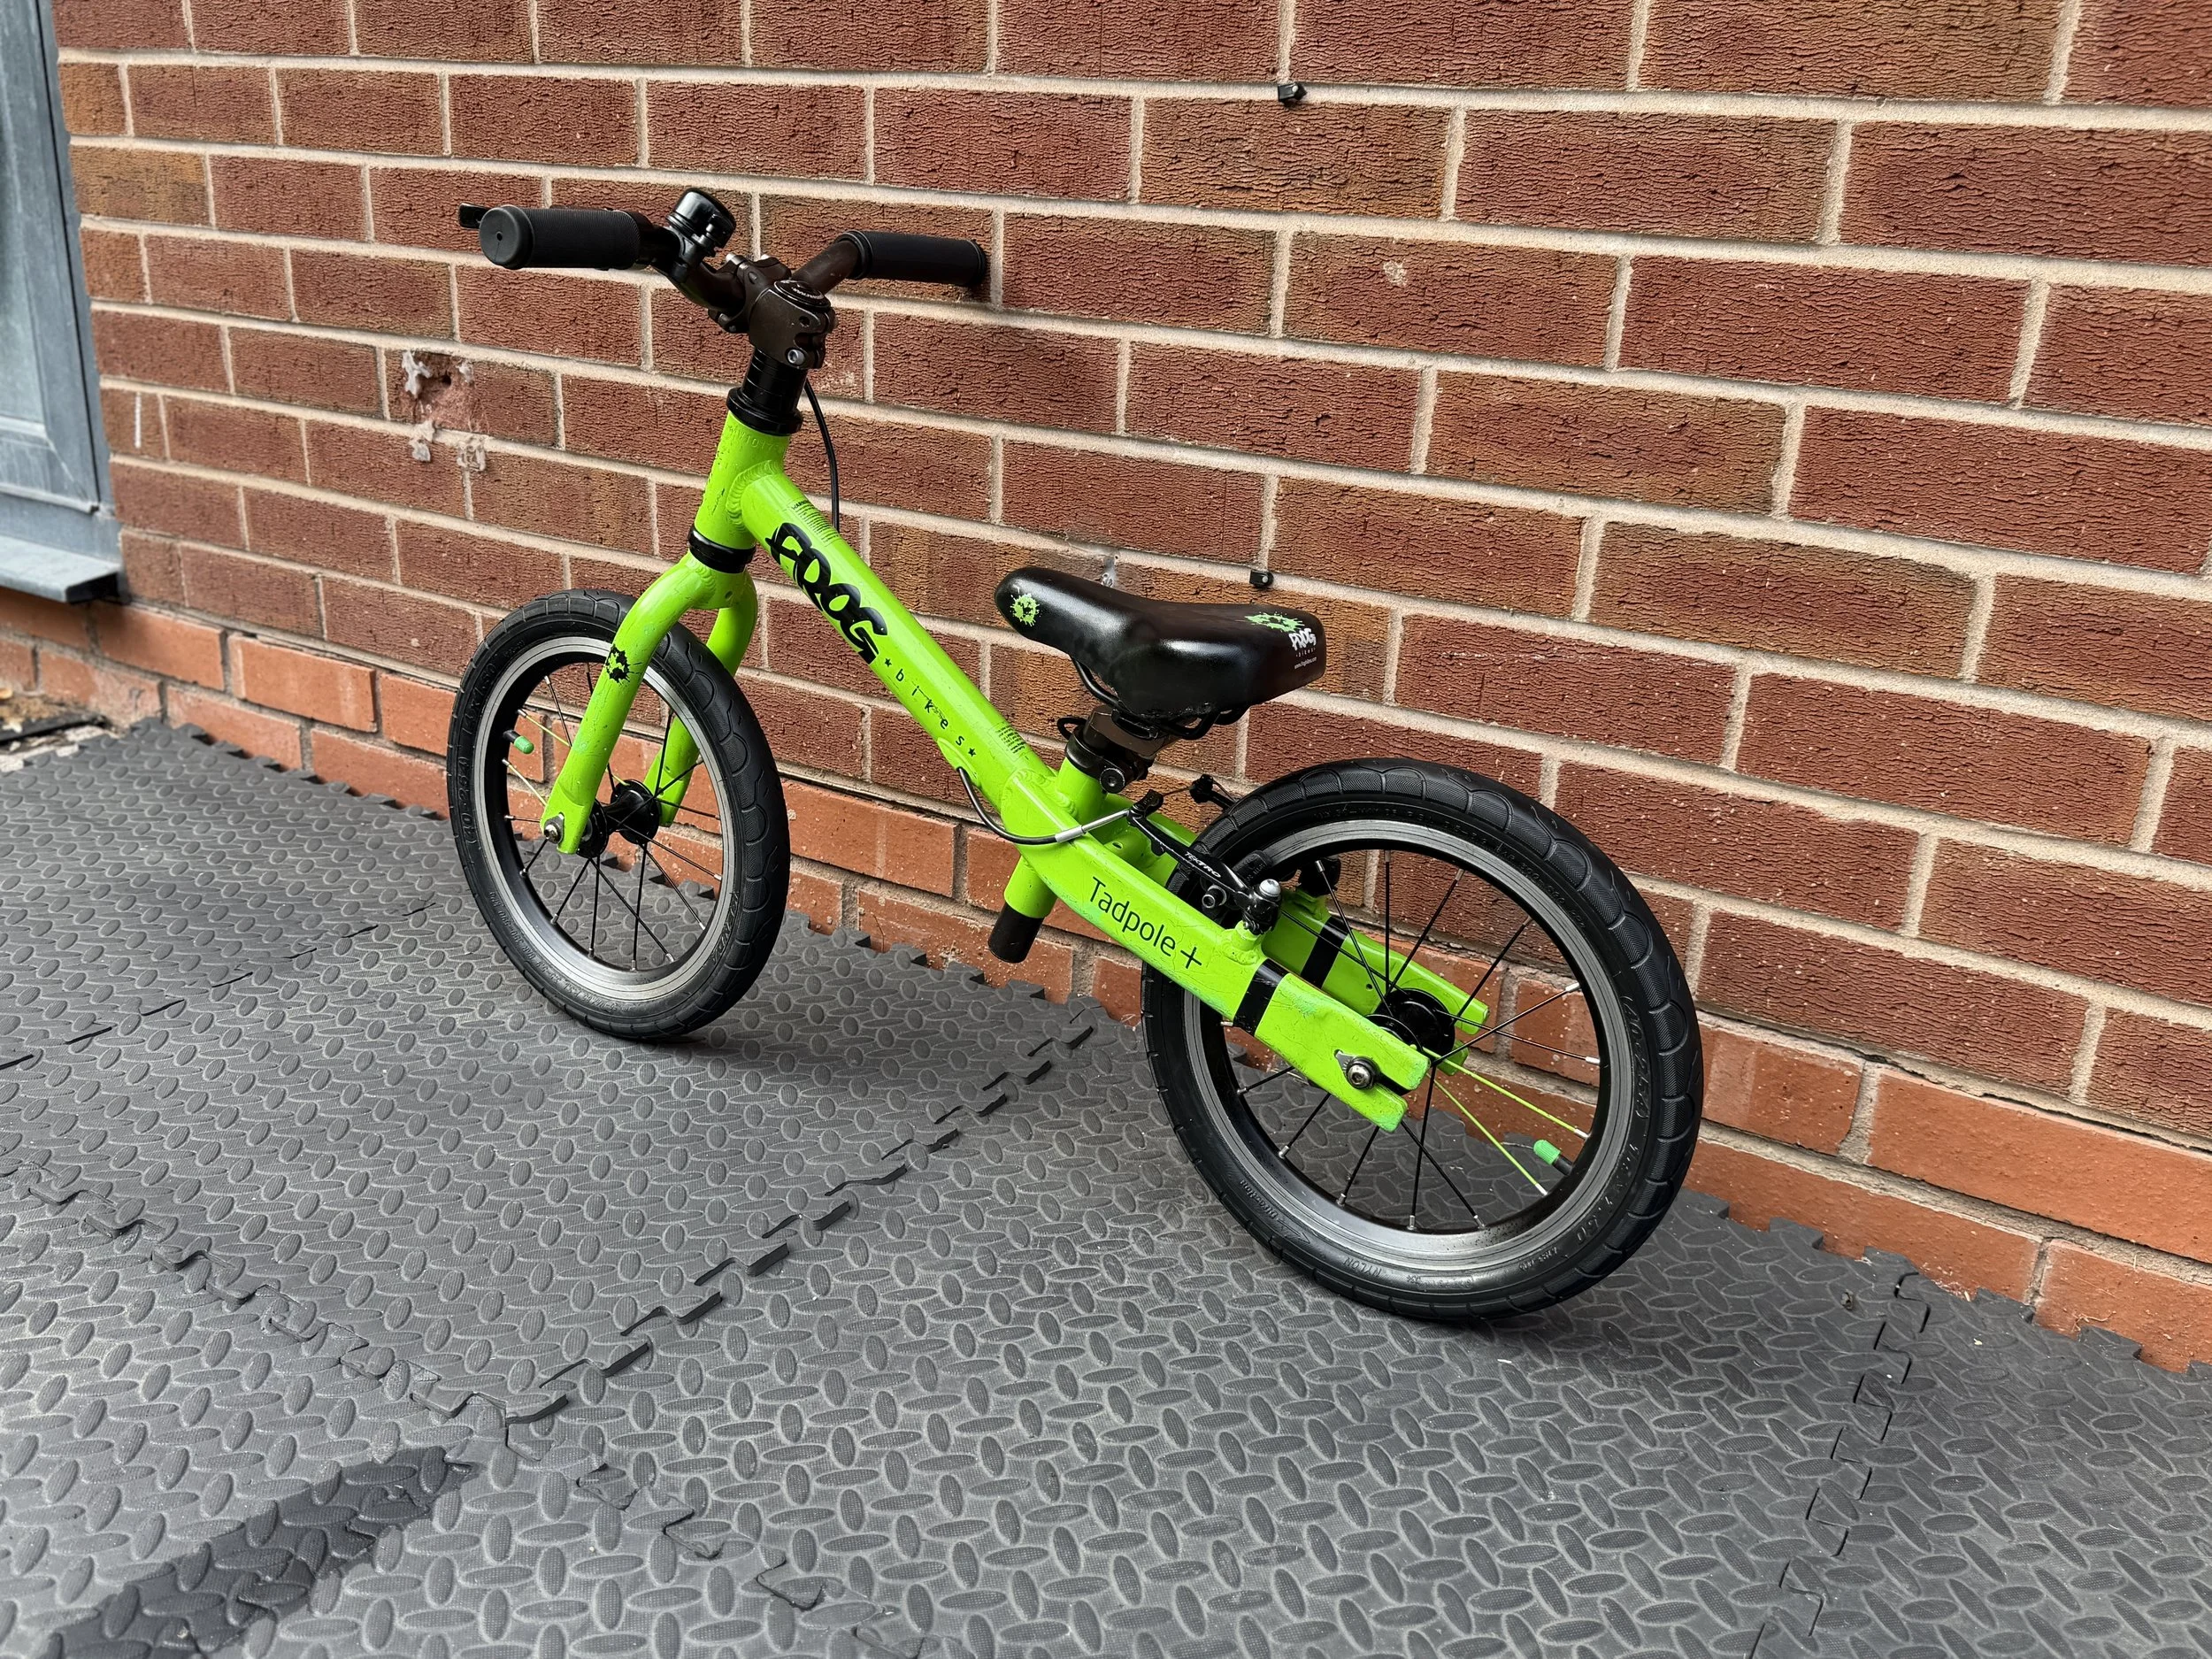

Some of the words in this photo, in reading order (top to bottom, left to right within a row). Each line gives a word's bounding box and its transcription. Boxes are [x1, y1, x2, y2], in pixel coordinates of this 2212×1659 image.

[765, 522, 887, 664] FROG
[1288, 628, 1317, 651] FROG
[895, 669, 965, 745] bikes
[1184, 850, 1222, 879] TEKTRO
[1343, 1256, 1382, 1277] NYLON
